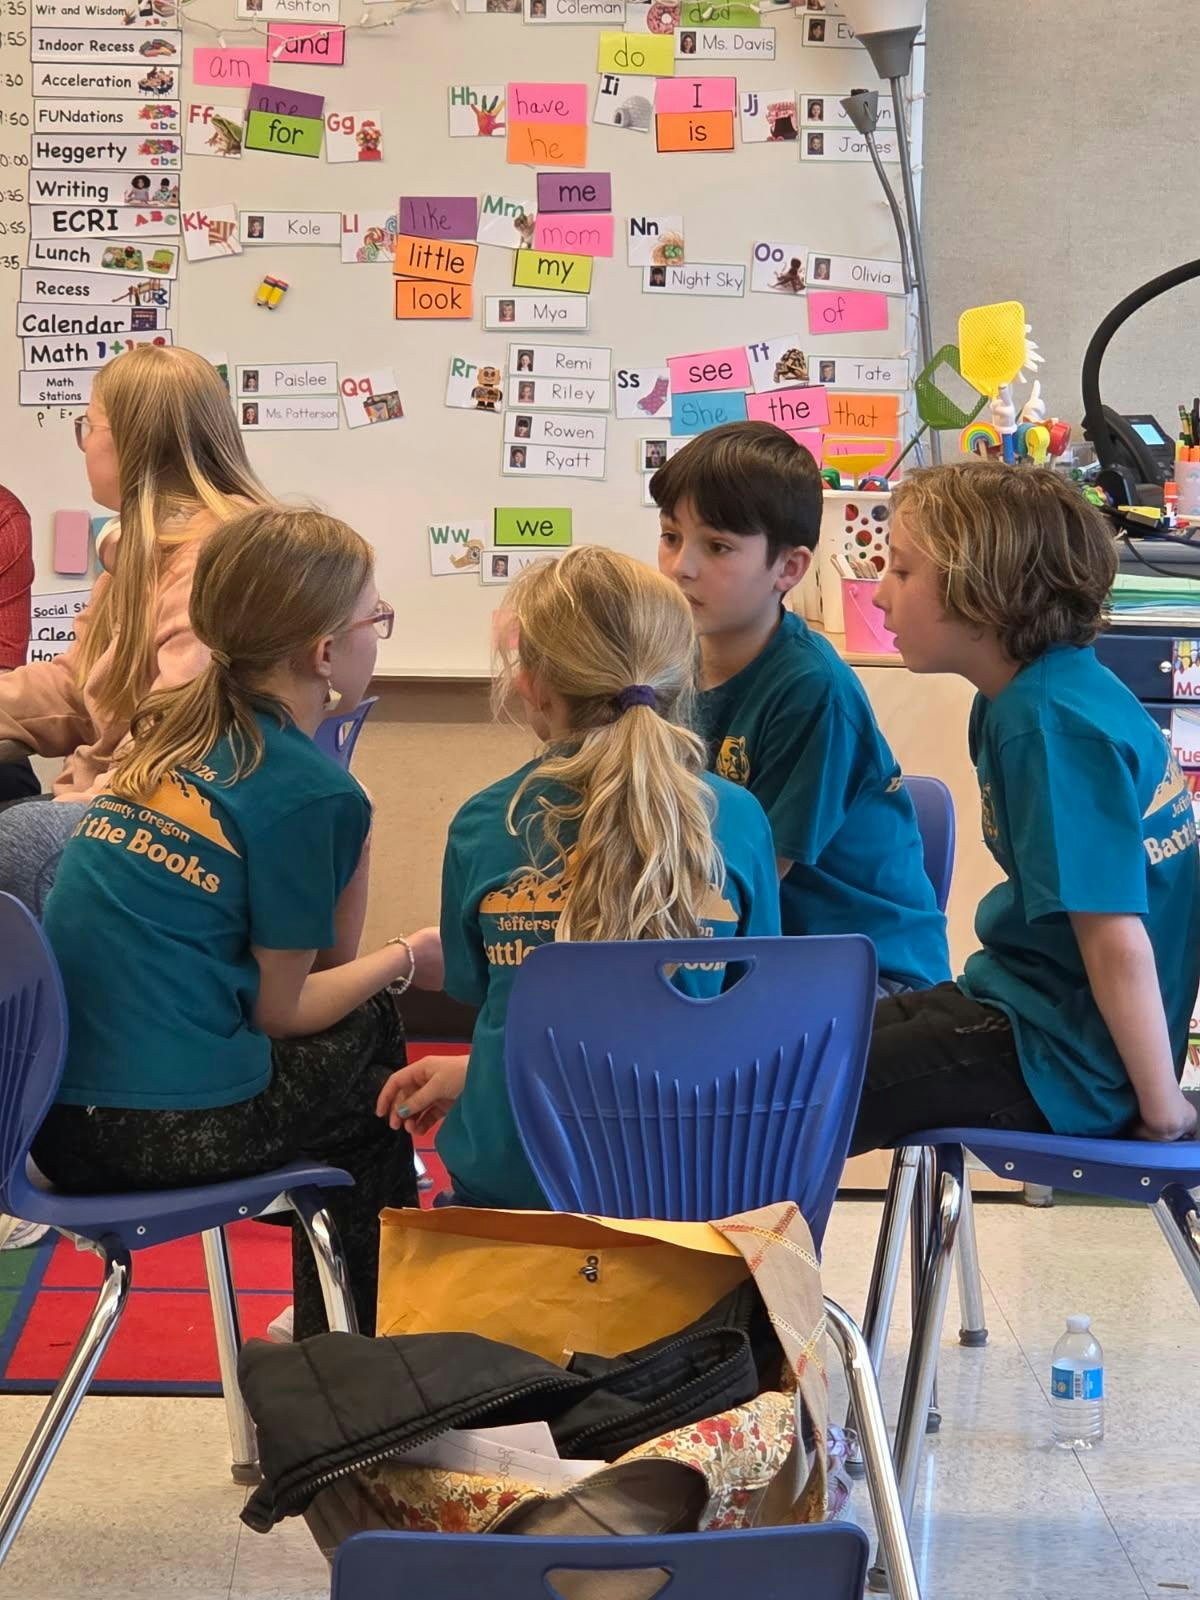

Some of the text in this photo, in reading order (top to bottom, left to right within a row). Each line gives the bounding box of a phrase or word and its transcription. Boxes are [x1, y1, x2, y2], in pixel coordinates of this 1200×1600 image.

[36, 5, 127, 16] Wit and Wisdom
[275, 0, 331, 13] Ashton
[556, 0, 622, 14] Coleman
[38, 39, 135, 52] Indoor Recess
[285, 31, 329, 56] and
[614, 36, 645, 67] do
[702, 34, 774, 51] Ms. Davis
[209, 56, 251, 78] am
[41, 74, 132, 89] Acceleration
[601, 74, 620, 96] Ii
[451, 86, 477, 105] Hh
[515, 89, 570, 116] have
[692, 84, 702, 108] I
[743, 93, 758, 116] Jj
[39, 109, 124, 123] FUNdations
[189, 105, 214, 124] Ff
[327, 113, 355, 135] Gg
[268, 119, 304, 145] for
[689, 121, 707, 141] is
[36, 142, 128, 163] Heggerty
[527, 128, 564, 159] he
[36, 179, 109, 203] Writing
[559, 184, 597, 203] me
[410, 202, 452, 231] like
[483, 195, 524, 219] Mm
[52, 208, 119, 232] ECRI
[182, 211, 211, 231] Kk
[288, 220, 321, 235] Kole
[630, 217, 659, 236] Nn
[542, 226, 601, 246] mom
[35, 243, 91, 263] Lunch
[409, 243, 465, 274] little
[754, 243, 784, 263] Oo
[537, 257, 574, 284] my
[671, 270, 744, 291] Night Sky
[851, 265, 891, 285] Olivia
[36, 281, 90, 297] Recess
[412, 287, 462, 310] look
[533, 304, 568, 322] Mya
[822, 296, 846, 323] of
[22, 314, 124, 334] Calendar
[31, 343, 88, 364] Math
[555, 353, 592, 370] Remi
[748, 342, 770, 363] Tt
[451, 357, 477, 379] Rr
[688, 362, 733, 383] see
[853, 364, 891, 381] Tate
[46, 377, 74, 388] Math
[274, 370, 327, 388] Paislee
[341, 377, 374, 399] Qq
[617, 370, 640, 388] Ss
[39, 391, 82, 401] Stations
[552, 384, 596, 402] Riley
[286, 407, 338, 419] Patterson
[681, 402, 728, 427] She
[767, 397, 810, 422] the
[833, 400, 878, 428] that
[543, 421, 594, 439] Rowen
[545, 451, 591, 470] Ryatt
[430, 525, 470, 544] Ww
[516, 519, 554, 537] we
[33, 604, 68, 617] Social
[93, 797, 191, 844] County, Oregon
[85, 816, 127, 844] the
[126, 828, 221, 894] Books
